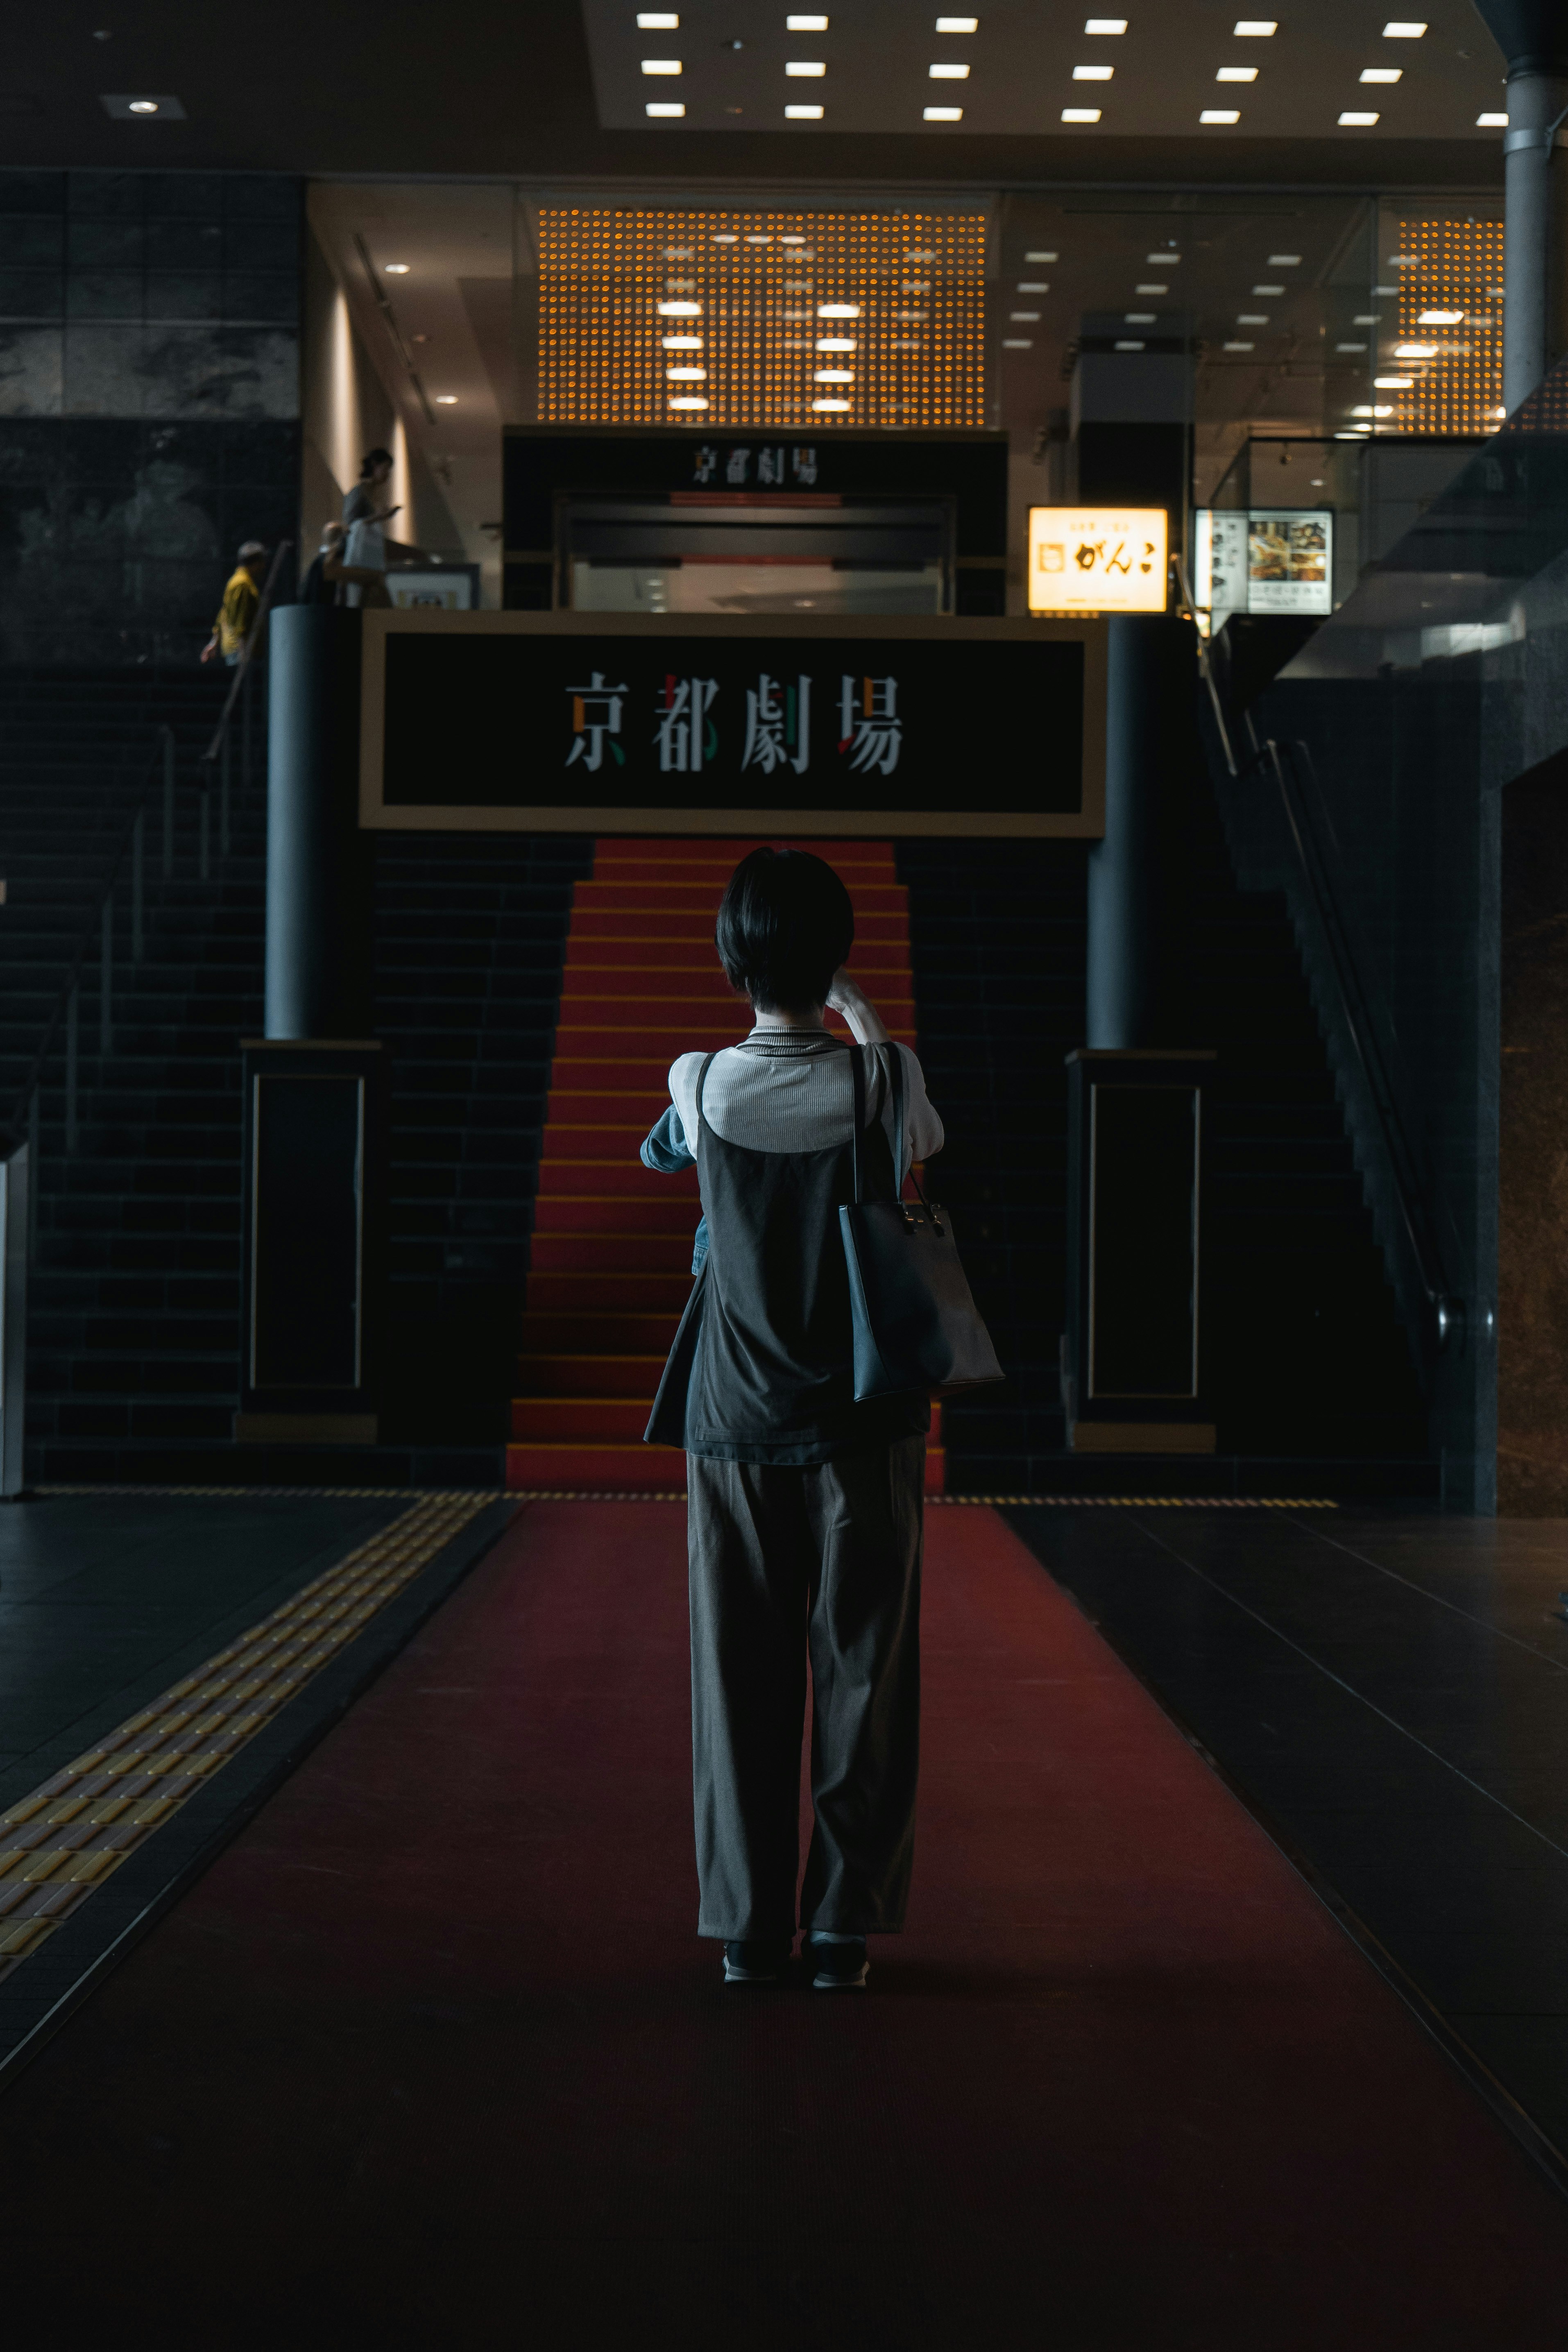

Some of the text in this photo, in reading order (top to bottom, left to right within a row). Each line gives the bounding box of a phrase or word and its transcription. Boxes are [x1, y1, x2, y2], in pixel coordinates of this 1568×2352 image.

[693, 445, 818, 485] 京都劇場
[1075, 541, 1155, 574] がんこ
[564, 671, 903, 775] 京都劇場
